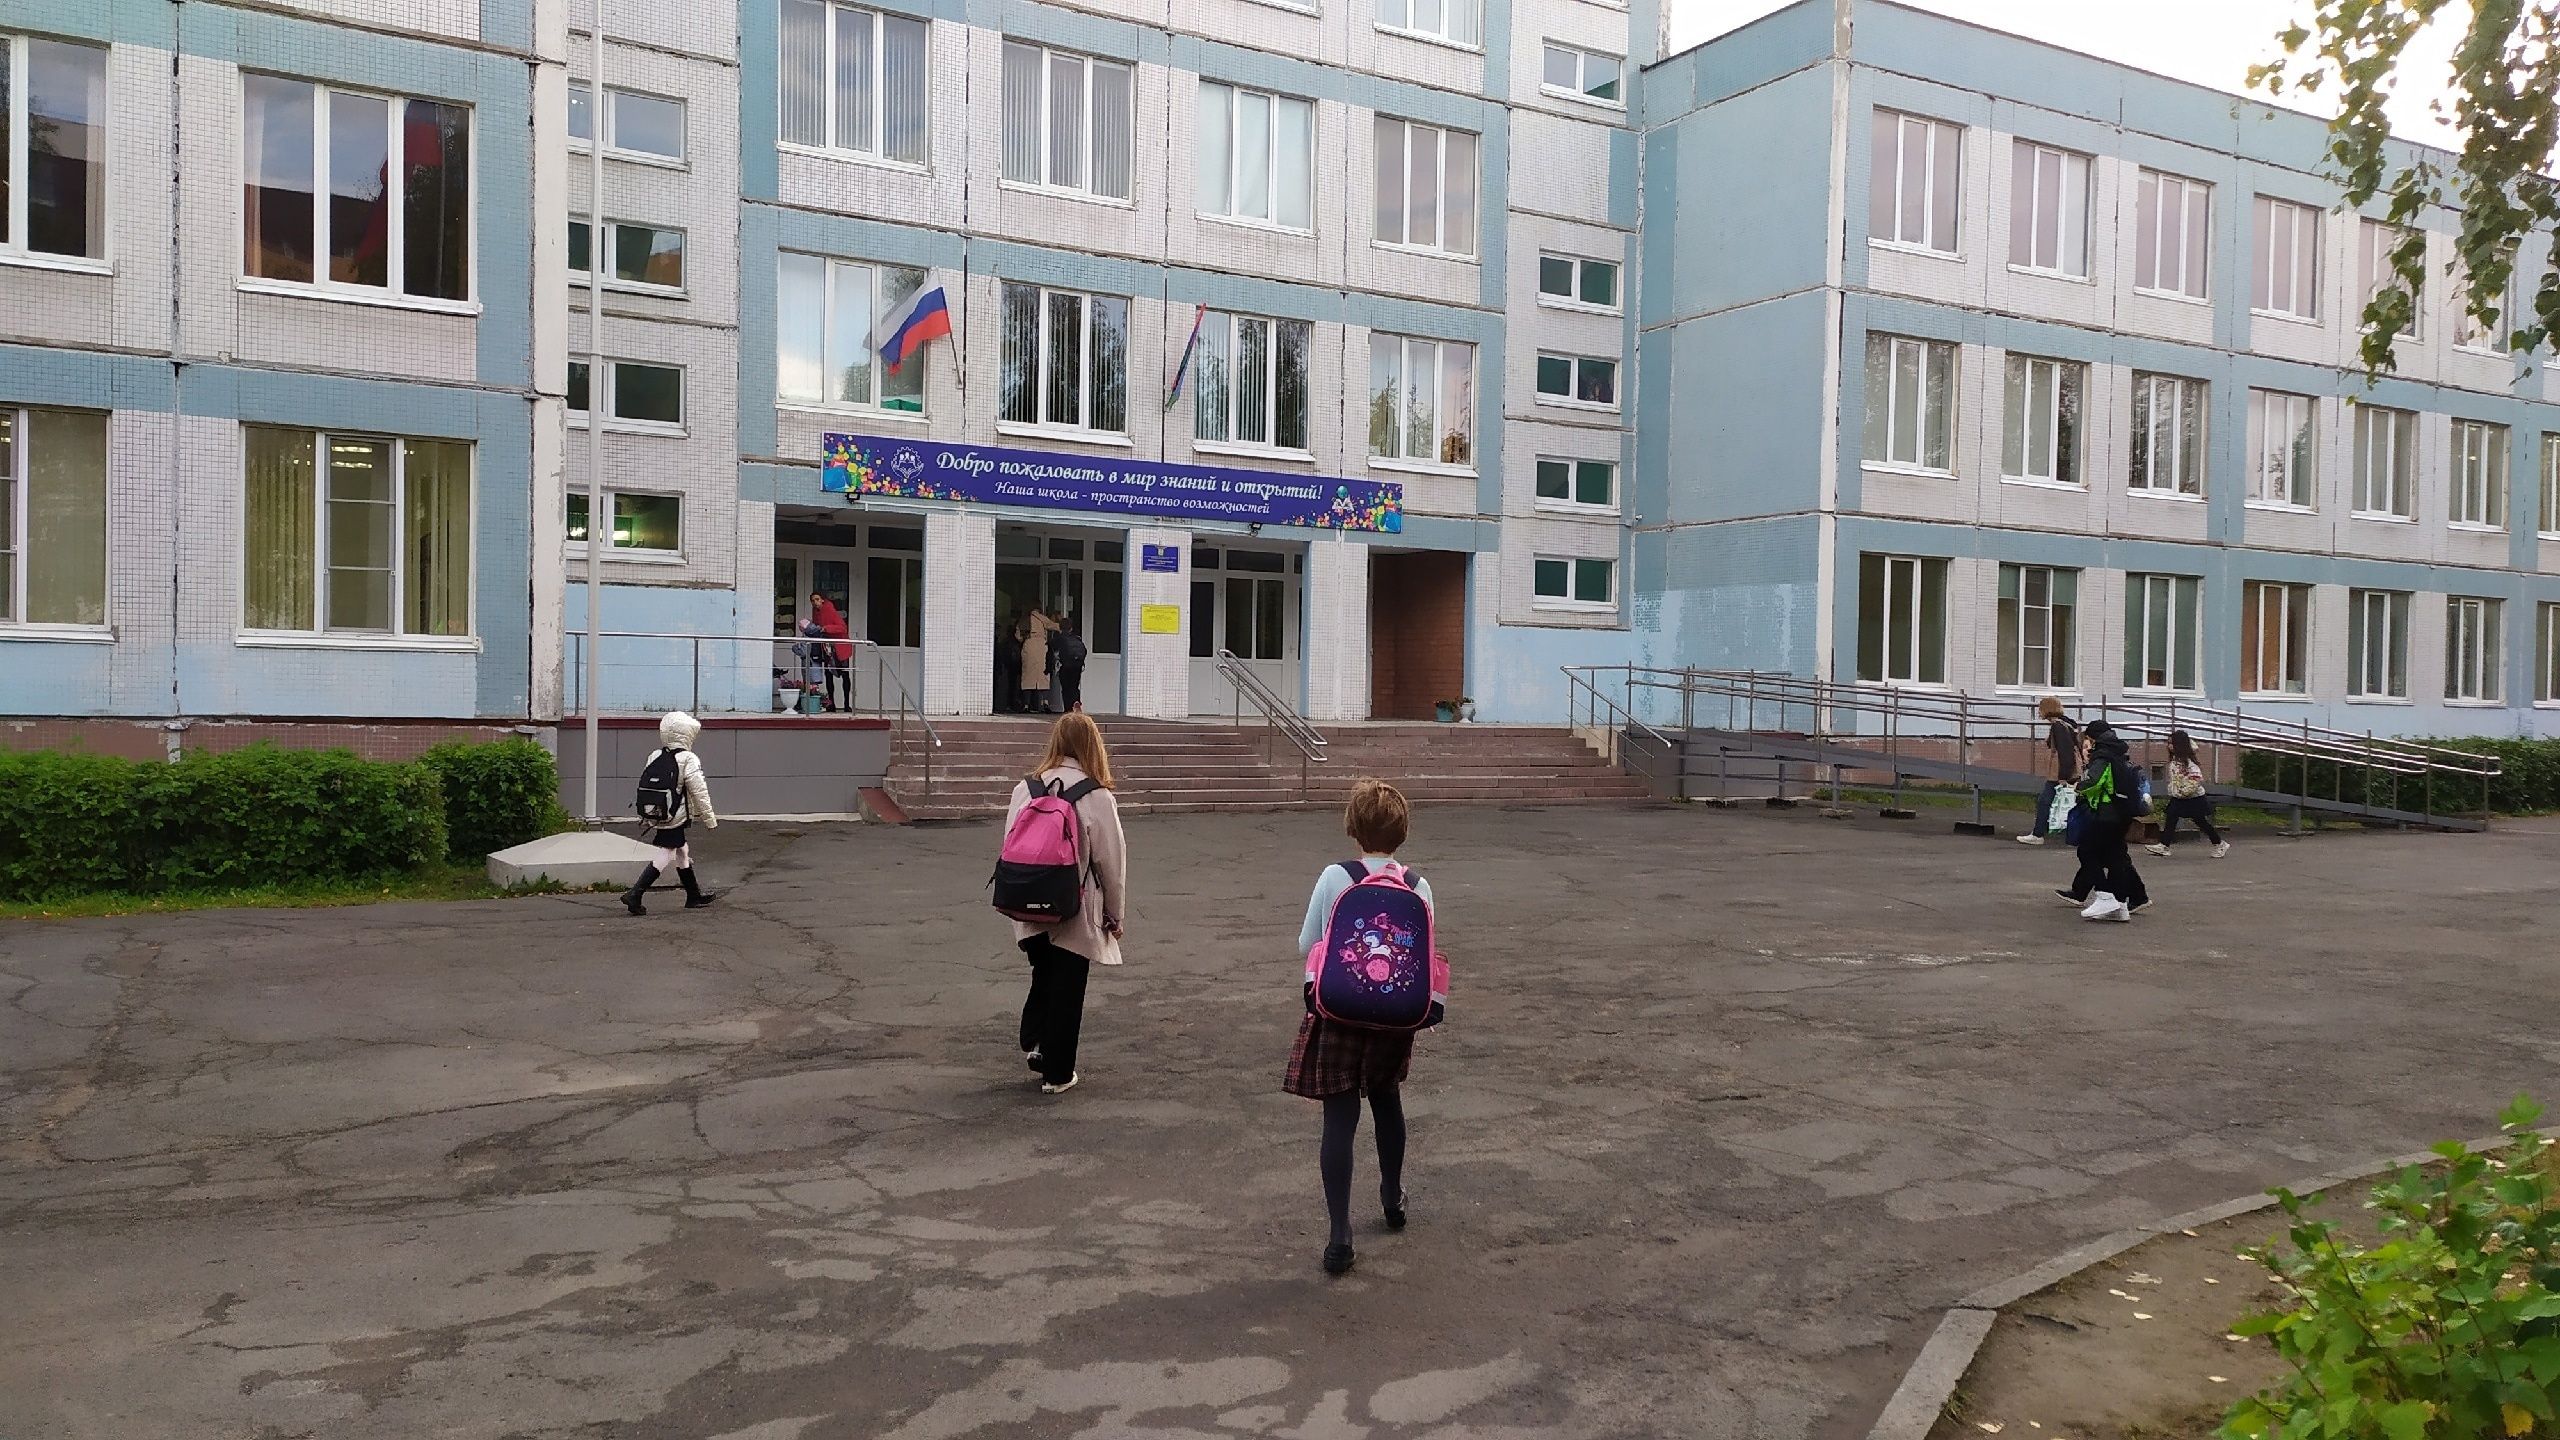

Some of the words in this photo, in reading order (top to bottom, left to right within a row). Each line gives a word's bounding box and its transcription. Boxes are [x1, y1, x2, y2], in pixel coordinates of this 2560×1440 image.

[936, 451, 994, 478] Добро
[999, 460, 1105, 482] пожаловать
[1109, 471, 1117, 483] в
[1120, 473, 1156, 491] мир
[1160, 475, 1216, 491] знаний
[1221, 481, 1232, 492] и
[1235, 481, 1323, 500] открытий!
[994, 482, 1035, 496] Наша
[1037, 487, 1078, 500] школа
[1091, 493, 1180, 508] пространство
[1182, 499, 1270, 514] возможностей
